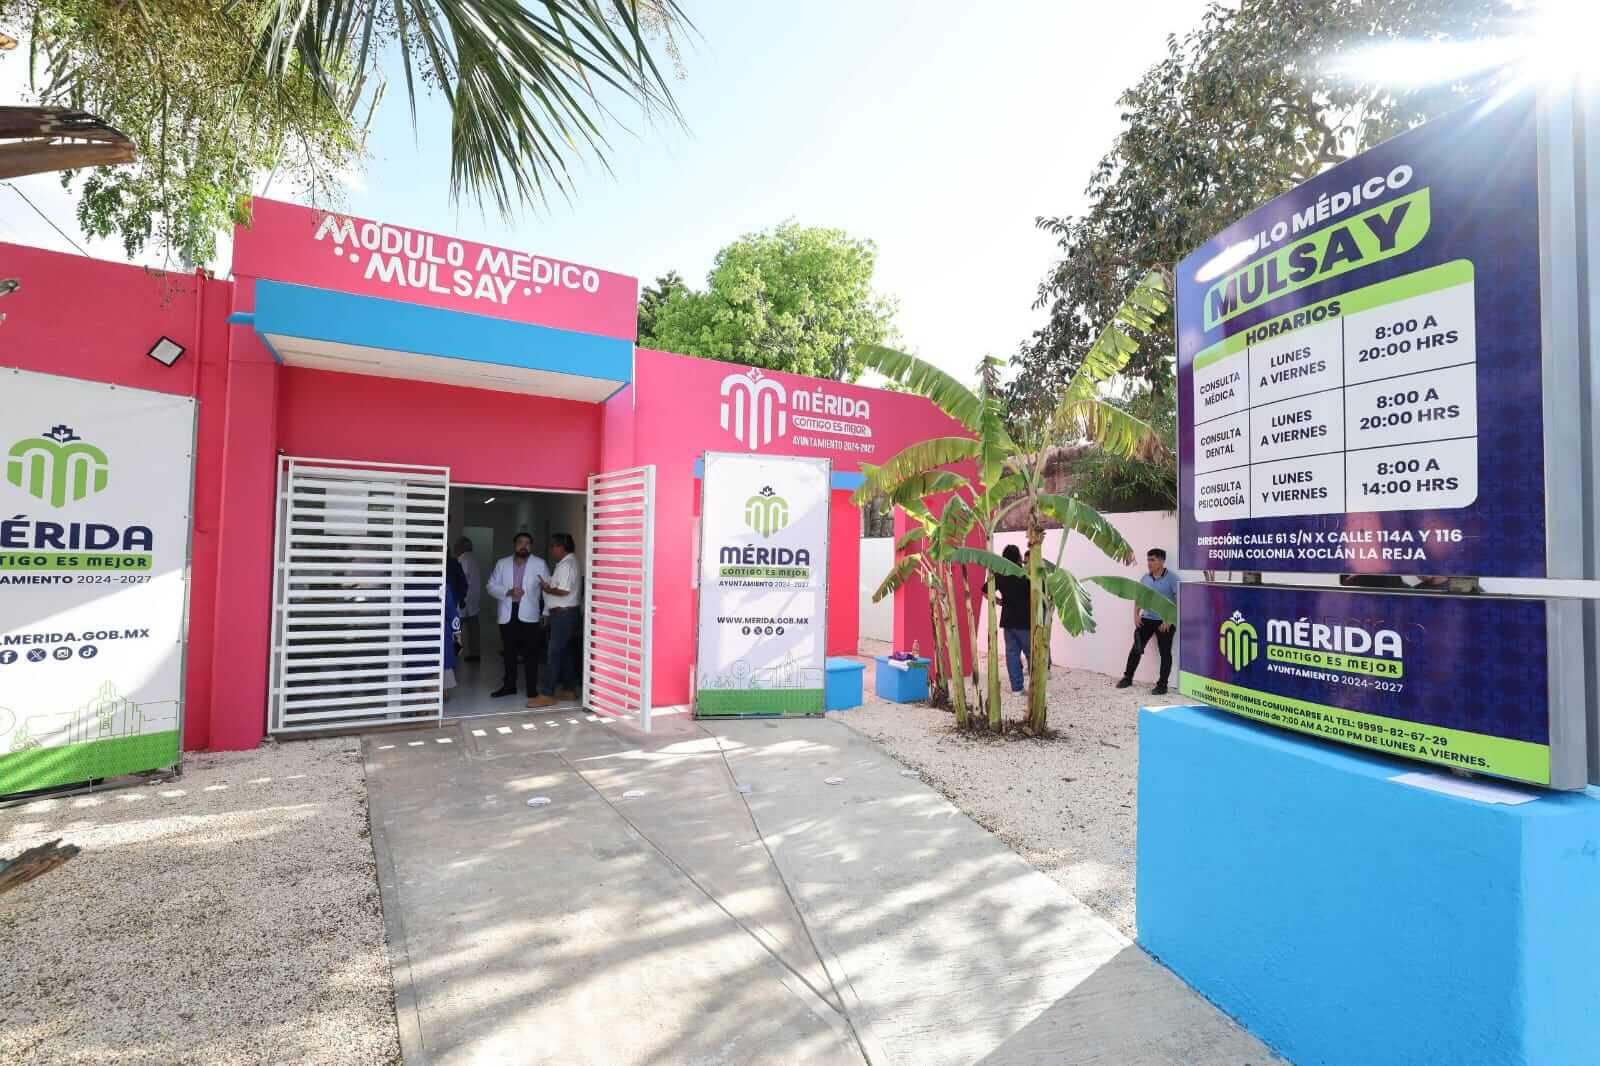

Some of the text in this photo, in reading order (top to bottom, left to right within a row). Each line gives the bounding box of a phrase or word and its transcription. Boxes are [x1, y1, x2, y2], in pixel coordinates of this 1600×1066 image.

[1292, 164, 1413, 233] MÉDICO
[1210, 201, 1412, 322] MULSAY
[364, 252, 516, 304] MULSAY
[1246, 301, 1341, 345] HORARIOS
[1375, 315, 1438, 340] 8:00 A
[1358, 330, 1459, 362] 20:00 HRS
[1270, 347, 1311, 368] LUNES
[1199, 372, 1241, 394] CONSULTA
[1259, 360, 1326, 388] A VIERNES
[792, 386, 870, 420] MÉRIDA
[1376, 387, 1439, 409] 8:00 A
[794, 417, 832, 431] CONTIGO
[832, 422, 842, 432] ES
[1271, 410, 1312, 428] LUNES
[1360, 404, 1460, 431] 20:00 HRS
[792, 435, 842, 450] AYUNTAMIENTO
[1200, 427, 1241, 446] CONSULTA
[1260, 425, 1327, 447] A VIERNES
[1206, 443, 1235, 459] DENTAL
[1377, 457, 1440, 476] 8:00 A
[1200, 481, 1242, 495] CONSULTA
[1272, 470, 1313, 486] LUNES
[1362, 477, 1459, 495] 14:00 HRS
[1198, 493, 1245, 509] PSICOLOGÍA
[1262, 487, 1328, 503] Y VIERNES
[1, 514, 153, 551] ÉRIDA
[1197, 529, 1463, 546] DIRECCIÓN: CALLE 61 S/N X CALLE 114A Y 116
[0, 556, 147, 568] TIGO ES MEJOR
[719, 544, 810, 566] MÉRIDA
[1208, 545, 1427, 560] ESQUINA COLONIA XOCLÁN LA REJA
[0, 575, 152, 584] AMIENTO 2024-2027
[722, 568, 762, 576] CONTIGO
[778, 569, 807, 577] MEJOR
[719, 580, 773, 588] AYUNTAMIENTO
[717, 616, 809, 625] WWW.MERIDA.GOB.MX
[0, 628, 150, 645] .MERIDA.GOB.MX
[1266, 617, 1403, 659] MÉRIDA
[1270, 648, 1398, 675] CONTIGO ES MEJOR
[1267, 664, 1403, 693] AYUNTAMIENTO 2024-2027
[1231, 692, 1261, 706] INFORMES
[1262, 700, 1321, 720] COMUNICARSE
[1323, 714, 1335, 724] AL
[1336, 716, 1355, 728] TEL:
[1245, 706, 1270, 718] horario
[1281, 715, 1299, 725] 7:00
[1300, 720, 1314, 730] AM
[1316, 724, 1323, 732] A
[1324, 725, 1345, 736] 2:00
[1346, 730, 1362, 741] PM
[1364, 734, 1378, 744] DE
[1380, 738, 1416, 753] LUNES
[1418, 746, 1427, 755] A
[1430, 748, 1491, 769] VIERNES.
